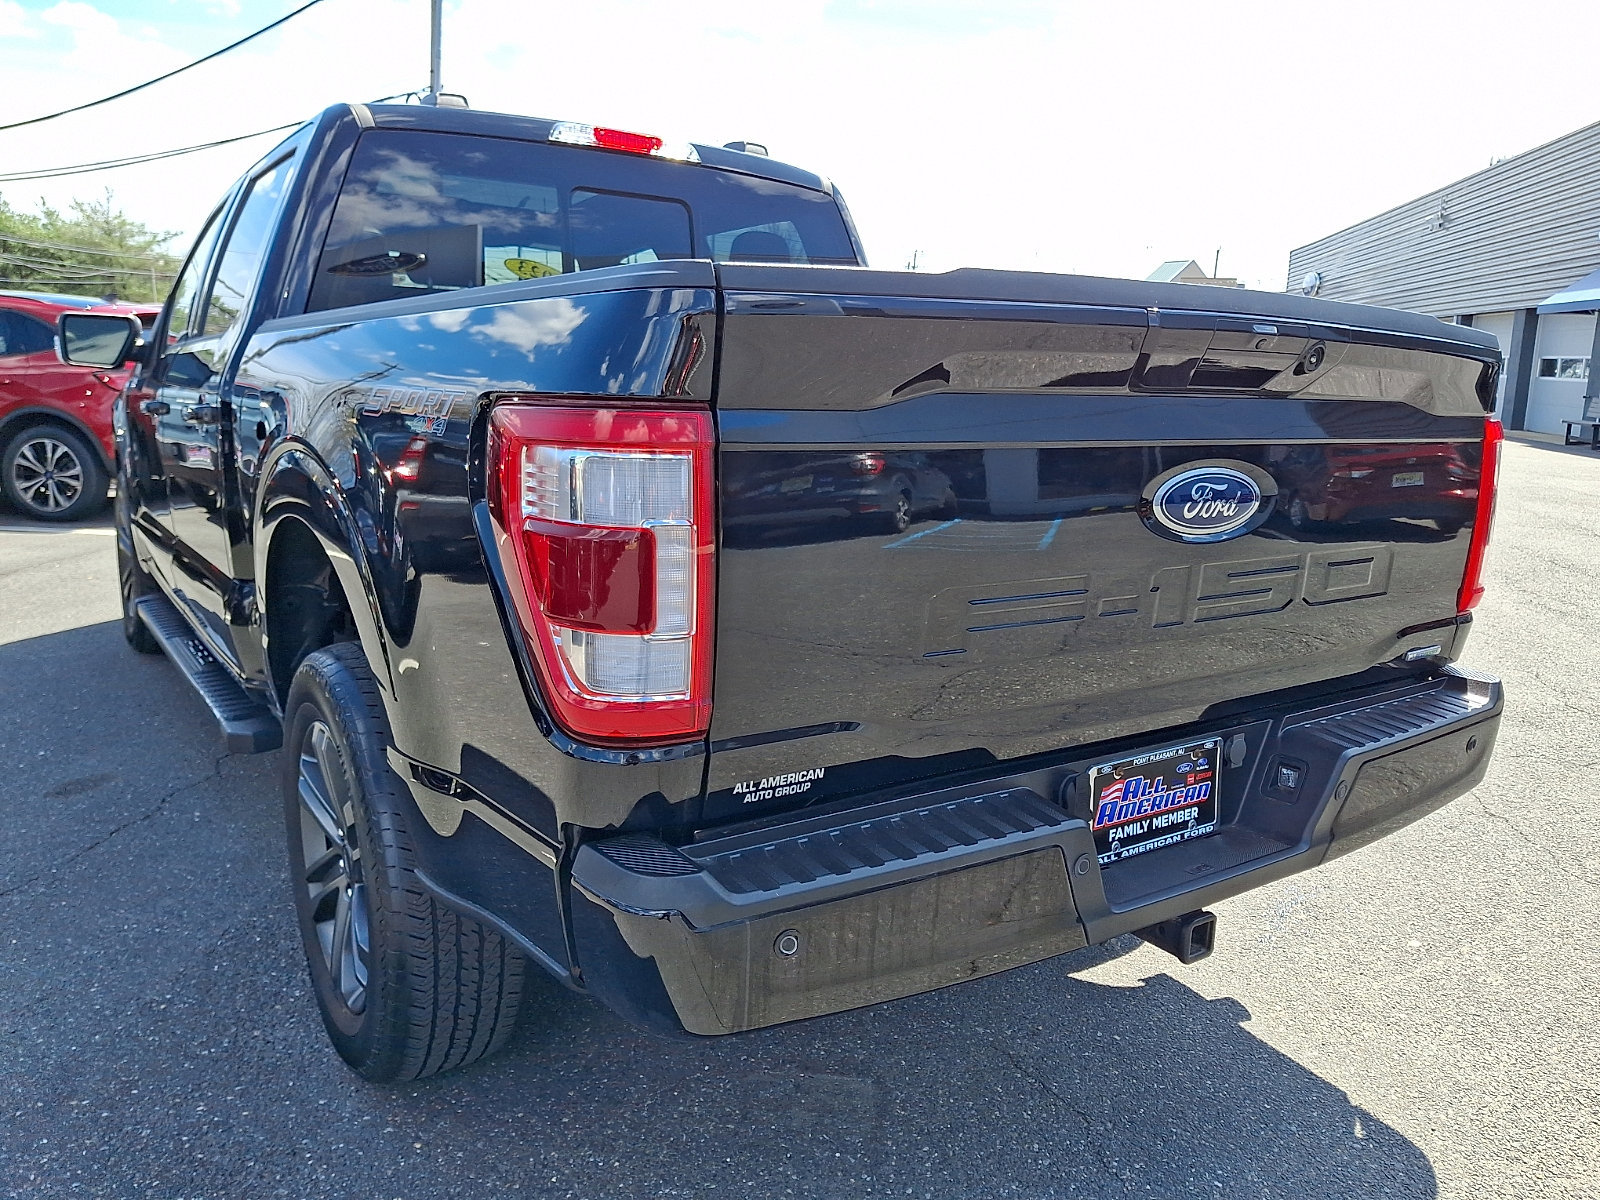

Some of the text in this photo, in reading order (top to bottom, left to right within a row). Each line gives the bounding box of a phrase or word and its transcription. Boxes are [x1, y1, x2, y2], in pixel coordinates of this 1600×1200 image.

[363, 385, 467, 418] SPORT
[1183, 482, 1241, 519] Ford
[924, 544, 1394, 657] F-150
[733, 768, 825, 794] ALL AMERICAN
[743, 782, 811, 803] AUTO GROUP
[1122, 776, 1167, 803] ALL
[1095, 781, 1211, 827] AMERICAN
[1108, 807, 1199, 842] FAMILY MEMBER
[1098, 825, 1214, 864] ALL AMERICAN FORD
